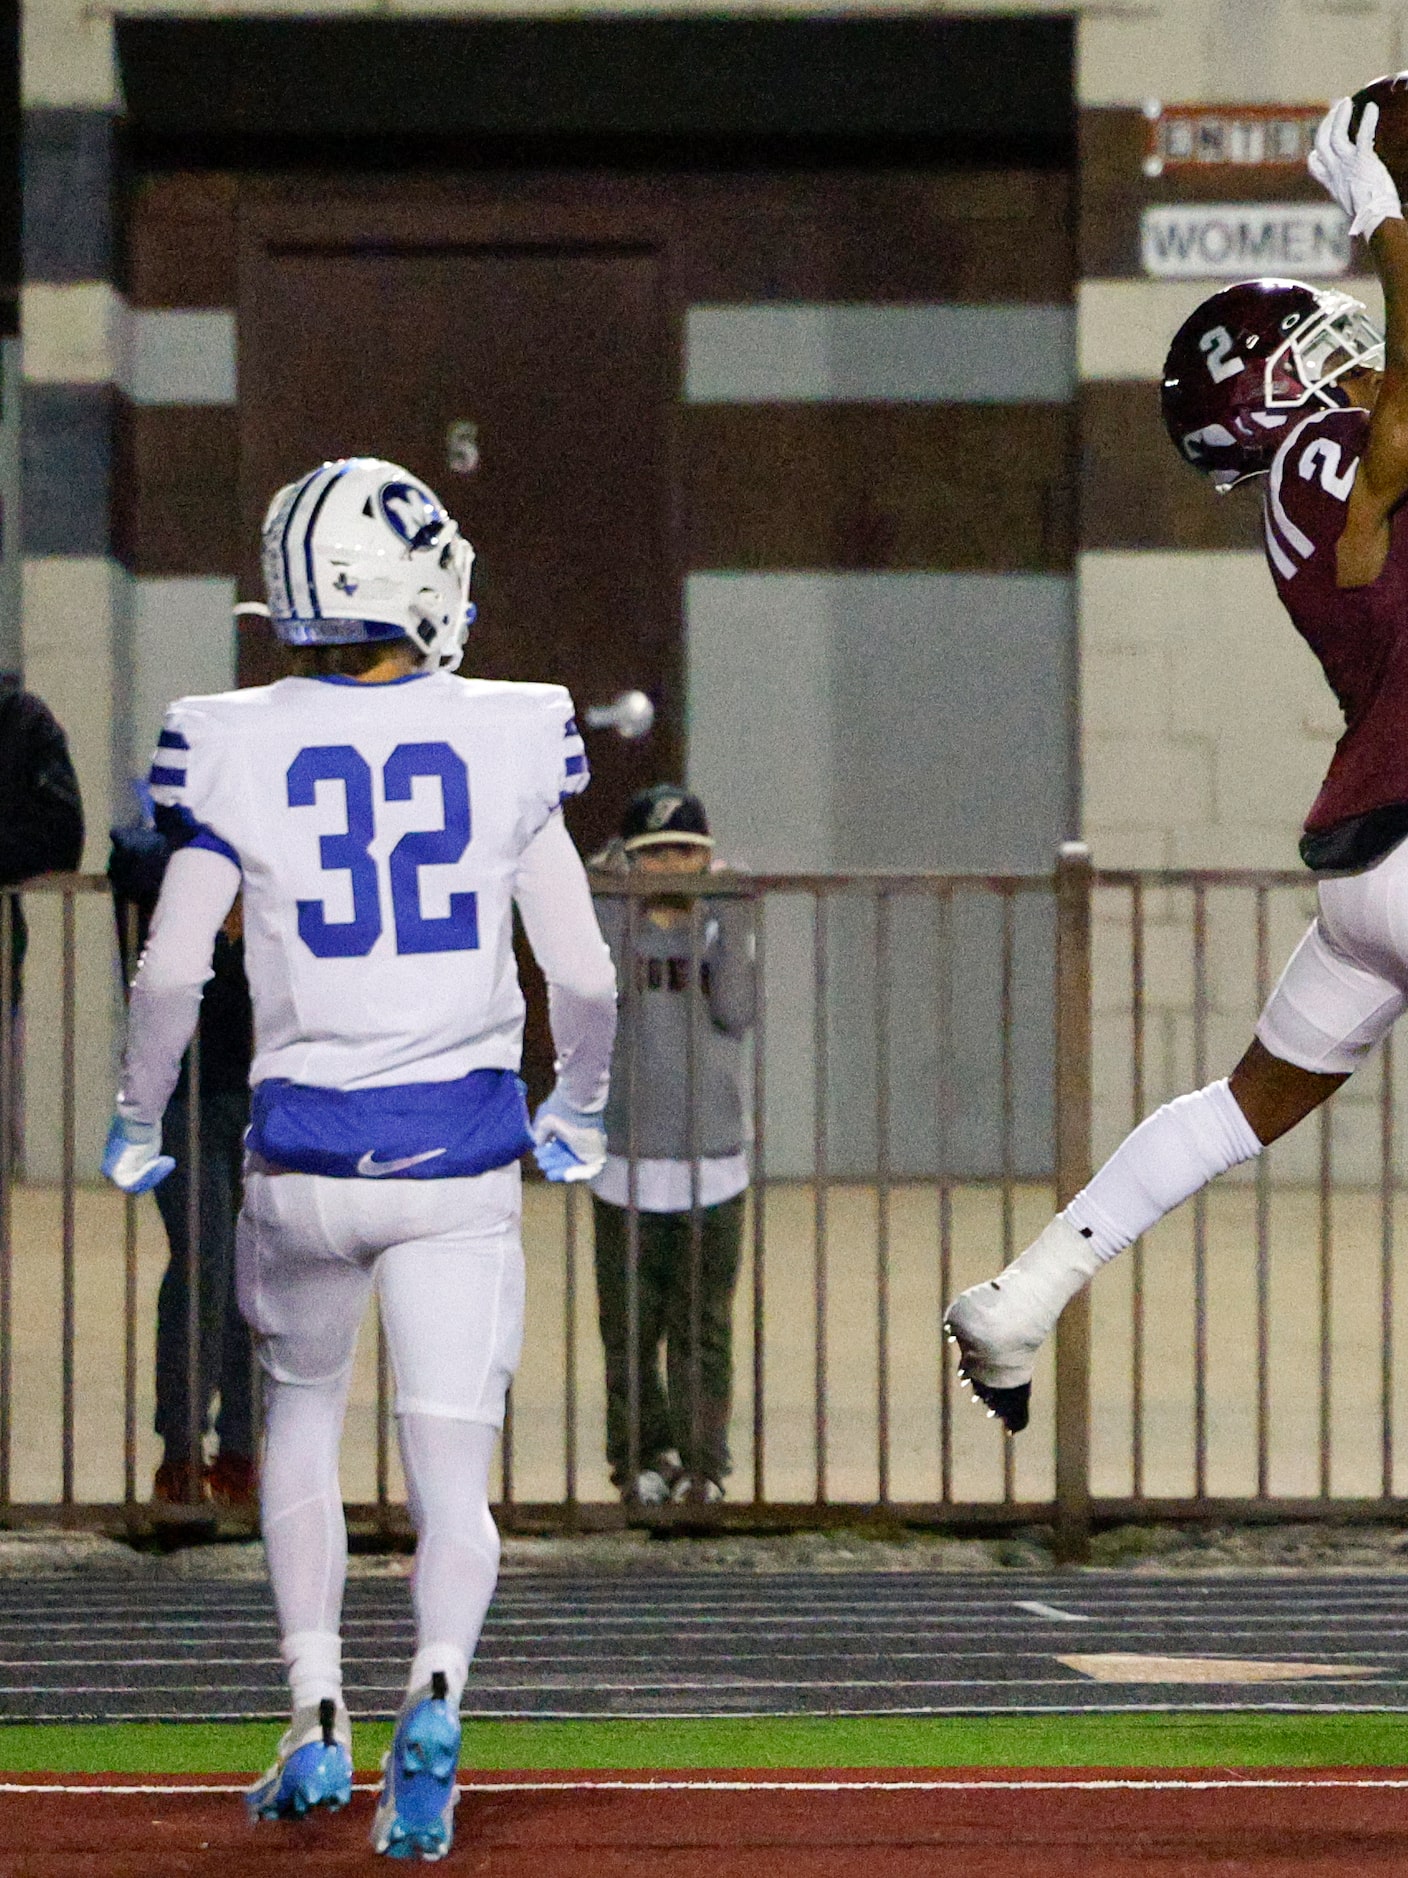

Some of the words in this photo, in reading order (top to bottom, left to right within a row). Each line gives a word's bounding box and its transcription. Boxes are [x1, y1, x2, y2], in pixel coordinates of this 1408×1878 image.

[1150, 220, 1349, 263] WOMEN
[1199, 325, 1245, 384] 2
[1298, 437, 1360, 501] 2
[286, 741, 480, 958] 32
